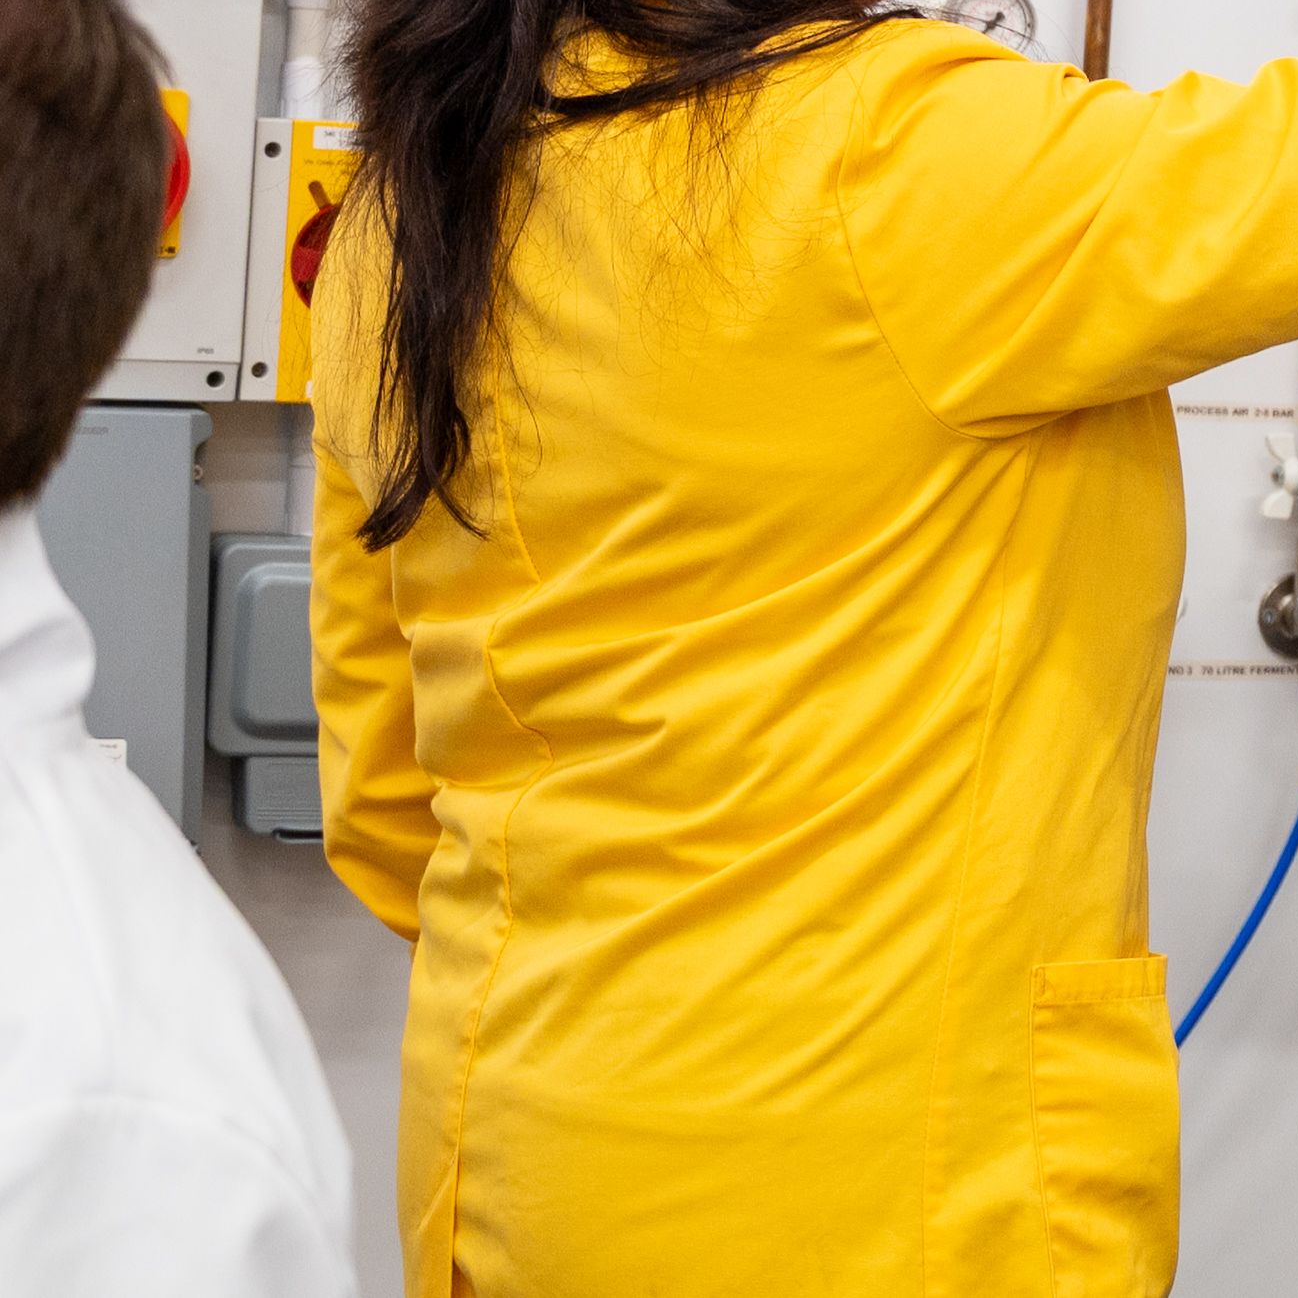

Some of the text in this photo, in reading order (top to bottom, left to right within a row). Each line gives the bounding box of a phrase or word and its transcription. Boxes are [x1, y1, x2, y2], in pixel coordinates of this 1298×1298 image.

[1176, 405, 1229, 416] PROCESS
[1232, 408, 1249, 416] AIR
[1272, 408, 1294, 418] BAR
[1216, 666, 1245, 675] LITRE
